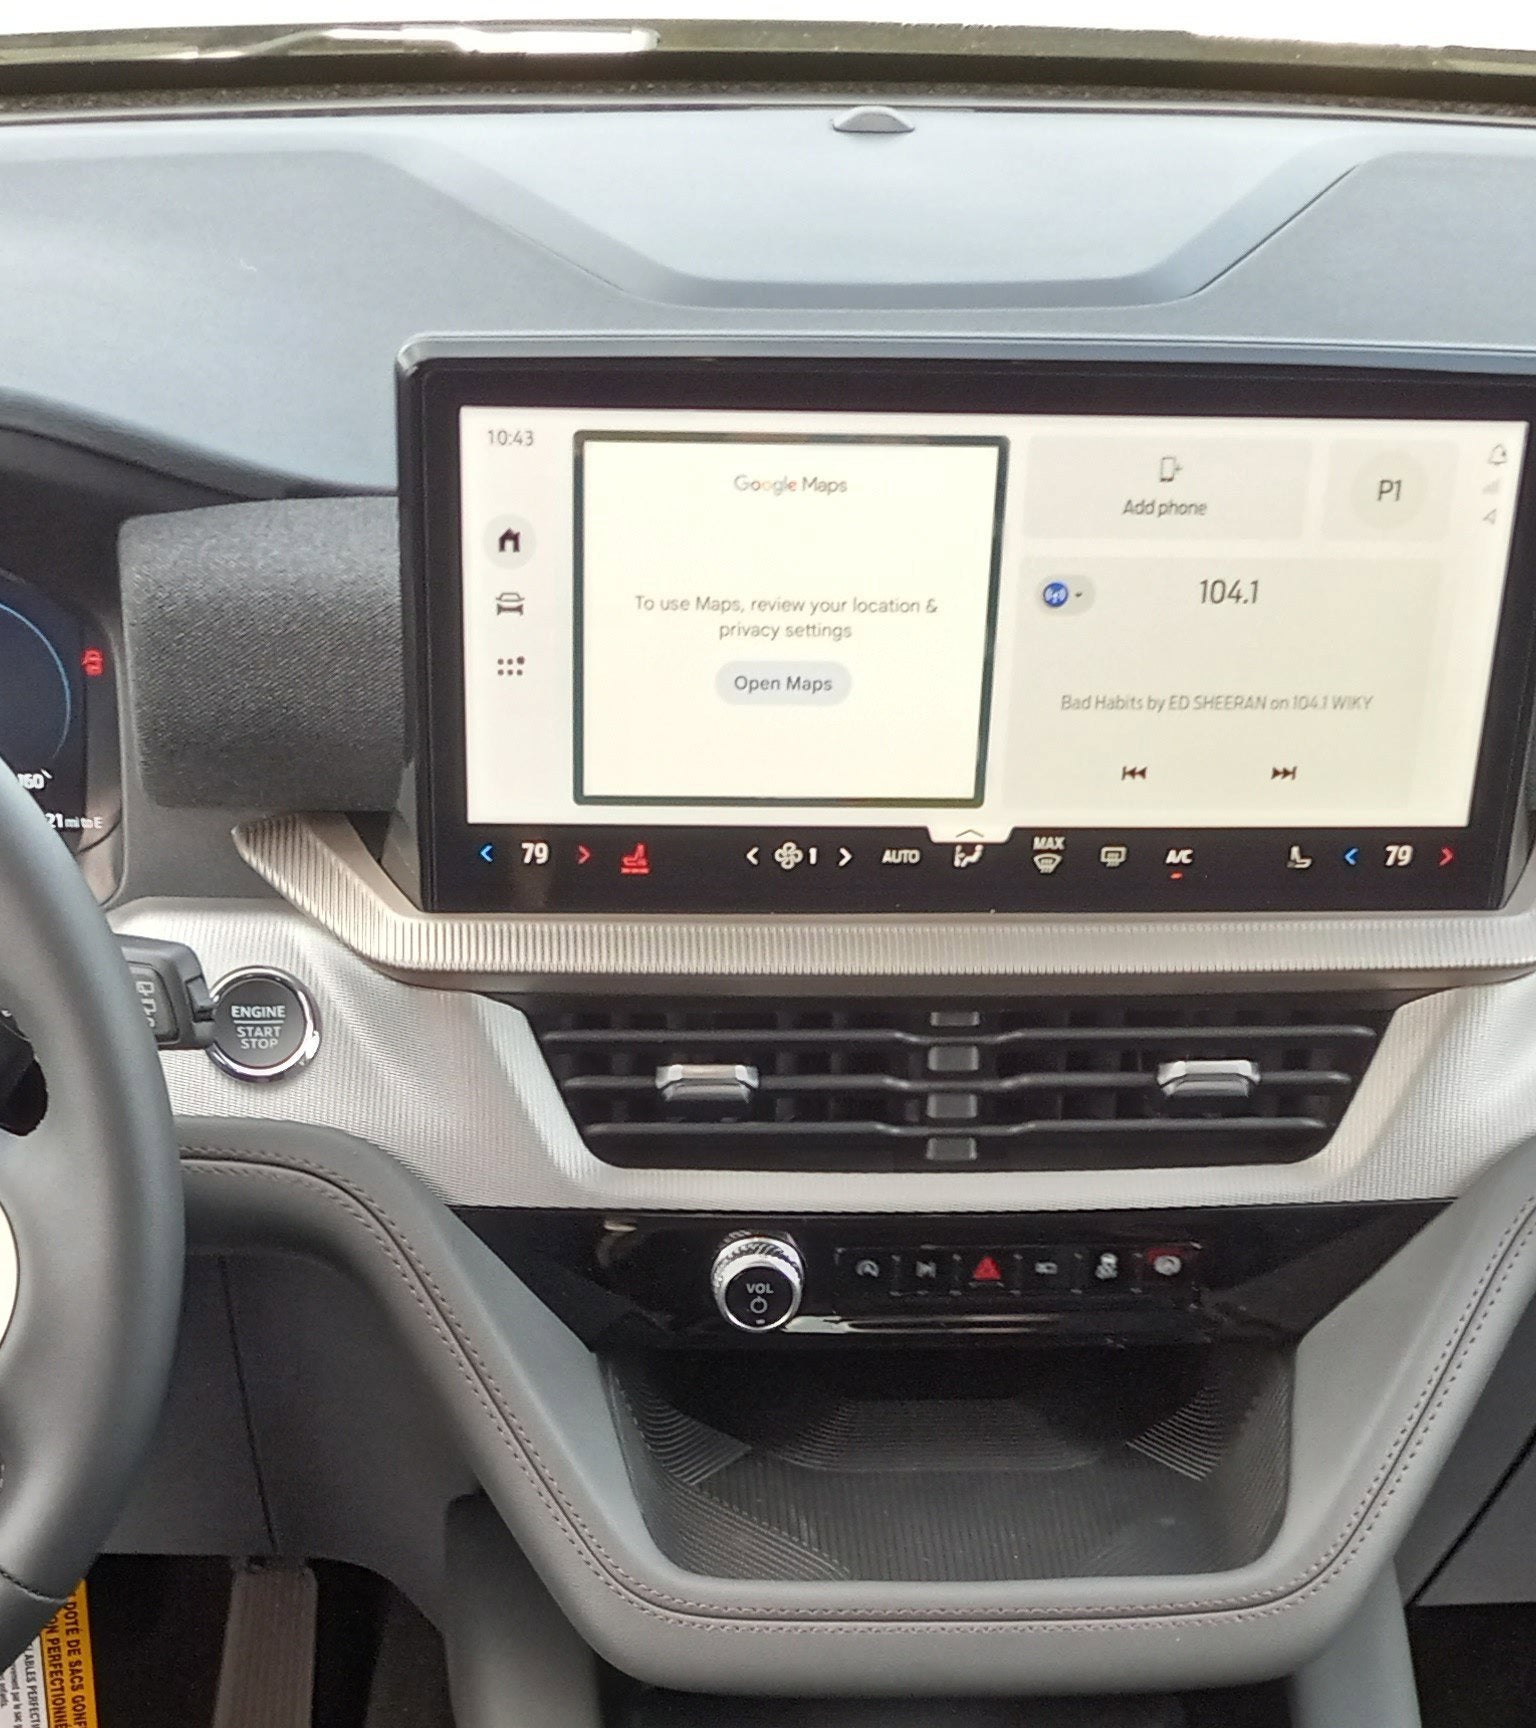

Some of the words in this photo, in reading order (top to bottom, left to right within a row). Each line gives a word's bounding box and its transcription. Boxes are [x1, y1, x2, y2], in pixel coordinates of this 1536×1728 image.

[487, 429, 534, 447] 10:43
[733, 474, 798, 496] Google
[801, 476, 848, 495] Maps
[1377, 480, 1403, 502] P1
[1122, 498, 1156, 517] Add
[1158, 499, 1208, 518] phone
[1199, 578, 1260, 606] 104.1
[635, 596, 655, 612] To
[660, 599, 691, 612] use
[695, 597, 746, 615] Maps,
[750, 598, 806, 614] review
[810, 601, 848, 617] your
[852, 598, 921, 614] location
[925, 599, 939, 614] &
[718, 622, 781, 642] privacy
[785, 622, 853, 642] settings
[734, 675, 781, 694] Open
[785, 676, 833, 693] Maps
[1062, 694, 1091, 711] Bad
[1095, 694, 1144, 711] Habits
[1146, 695, 1165, 714] by
[1168, 694, 1190, 711] ED
[1193, 694, 1268, 711] SHEERAN
[1270, 698, 1290, 711] on
[1292, 694, 1329, 711] 104.1
[1331, 694, 1374, 711] WIKY
[1032, 836, 1065, 851] MAX
[520, 842, 549, 865] 79
[807, 848, 817, 865] 1
[881, 849, 920, 865] AUTO
[1166, 847, 1193, 865] A/C
[1384, 845, 1413, 867] 79
[231, 1005, 286, 1019] ENGINE
[237, 1026, 281, 1038] START
[241, 1037, 278, 1049] STOP
[745, 1282, 775, 1294] VOL
[67, 1639, 81, 1656] DE
[68, 1661, 85, 1692] SACS
